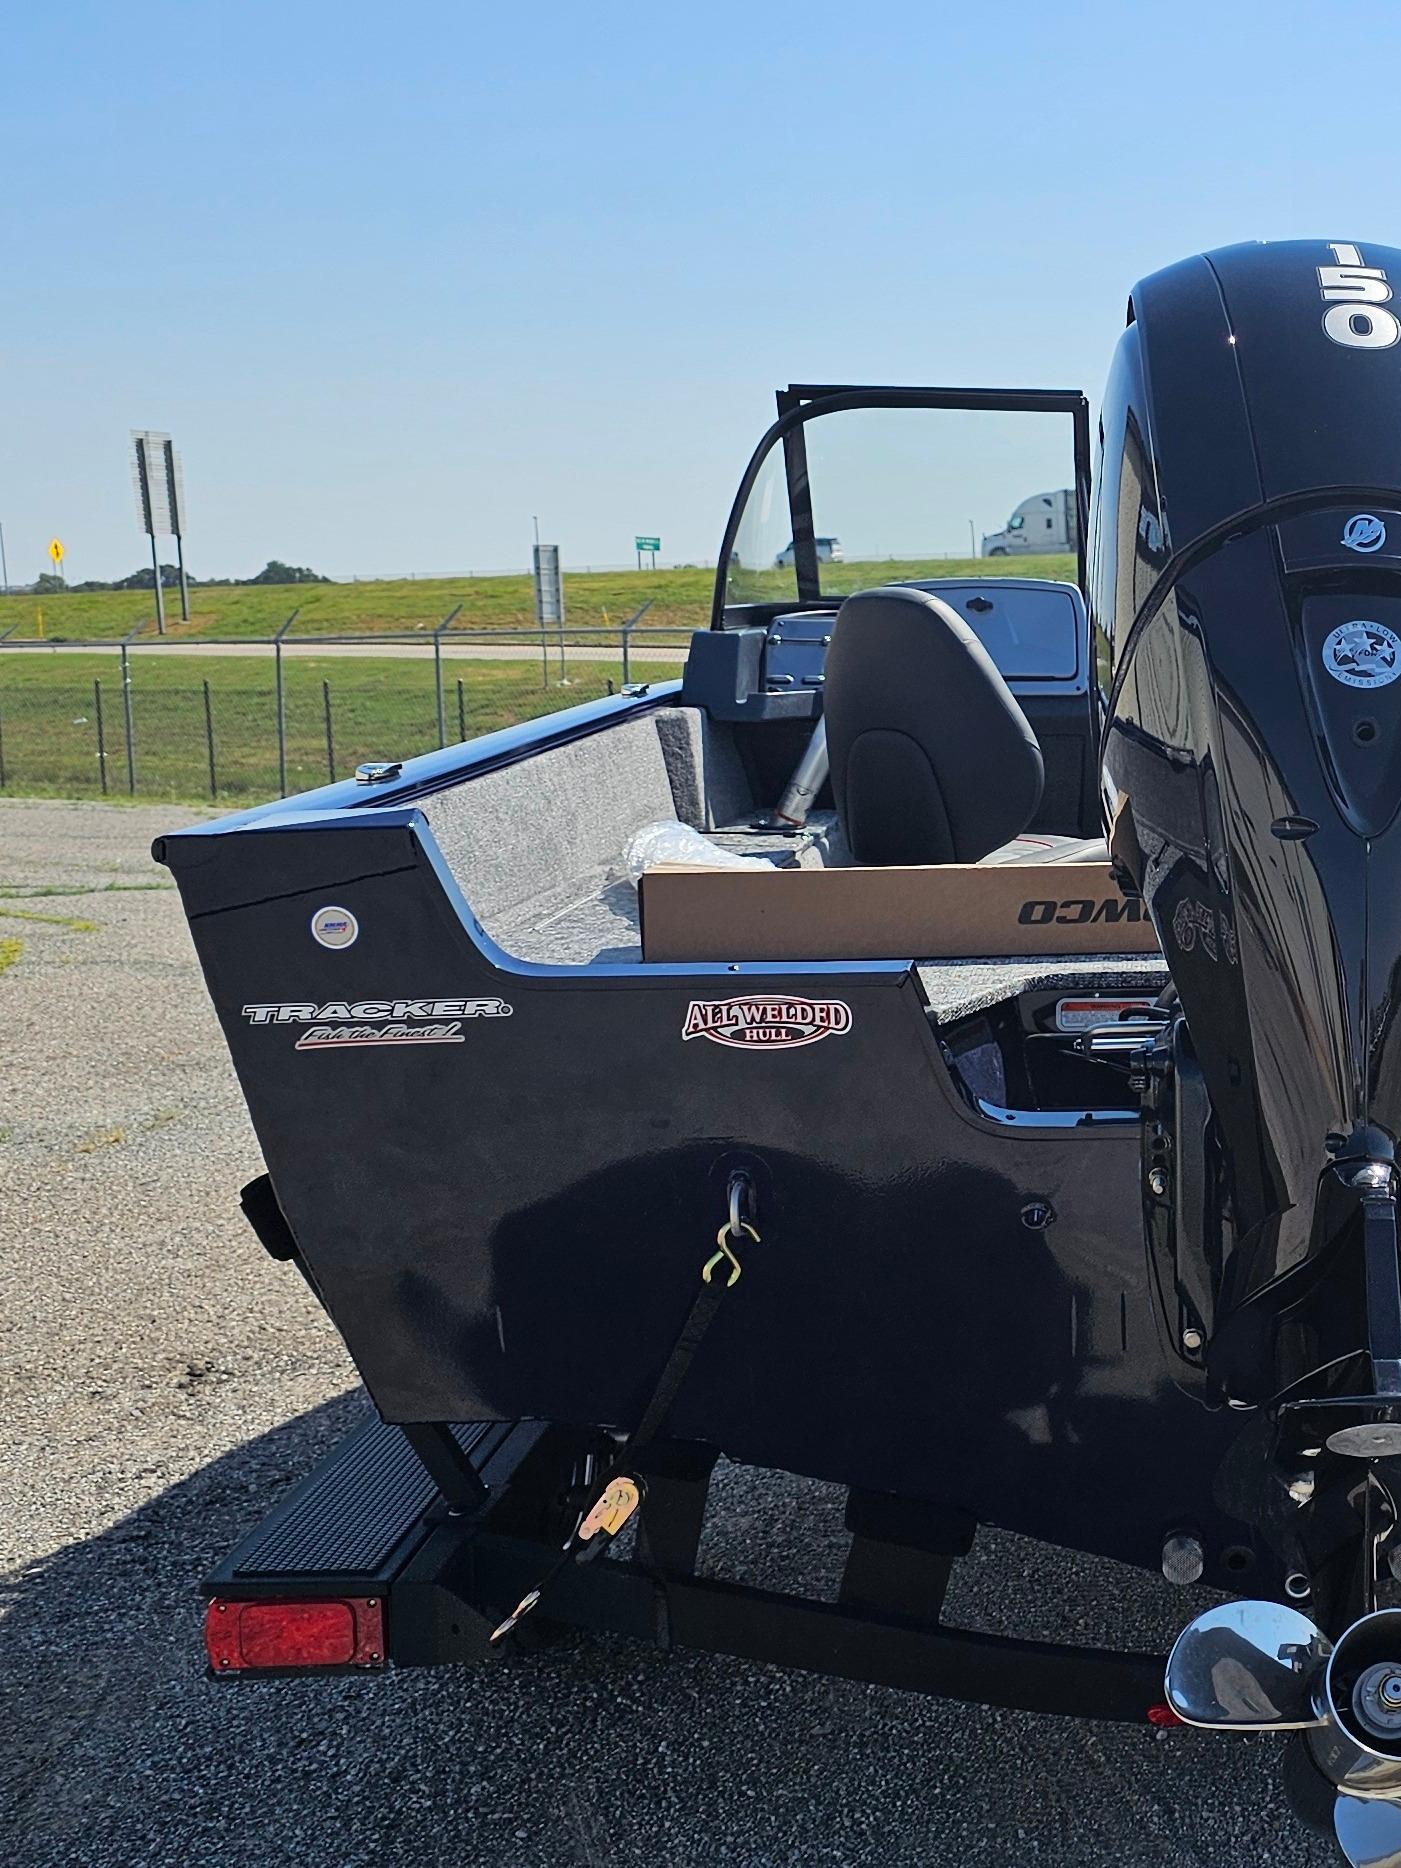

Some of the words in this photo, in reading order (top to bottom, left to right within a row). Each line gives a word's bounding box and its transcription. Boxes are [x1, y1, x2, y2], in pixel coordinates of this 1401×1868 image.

[1315, 243, 1401, 350] 150
[1376, 626, 1399, 643] LOW
[687, 1004, 739, 1034] ALL
[740, 1003, 848, 1031] WELDED
[303, 1026, 345, 1041] Fish
[348, 1026, 376, 1040] the
[744, 1028, 792, 1041] HULL
